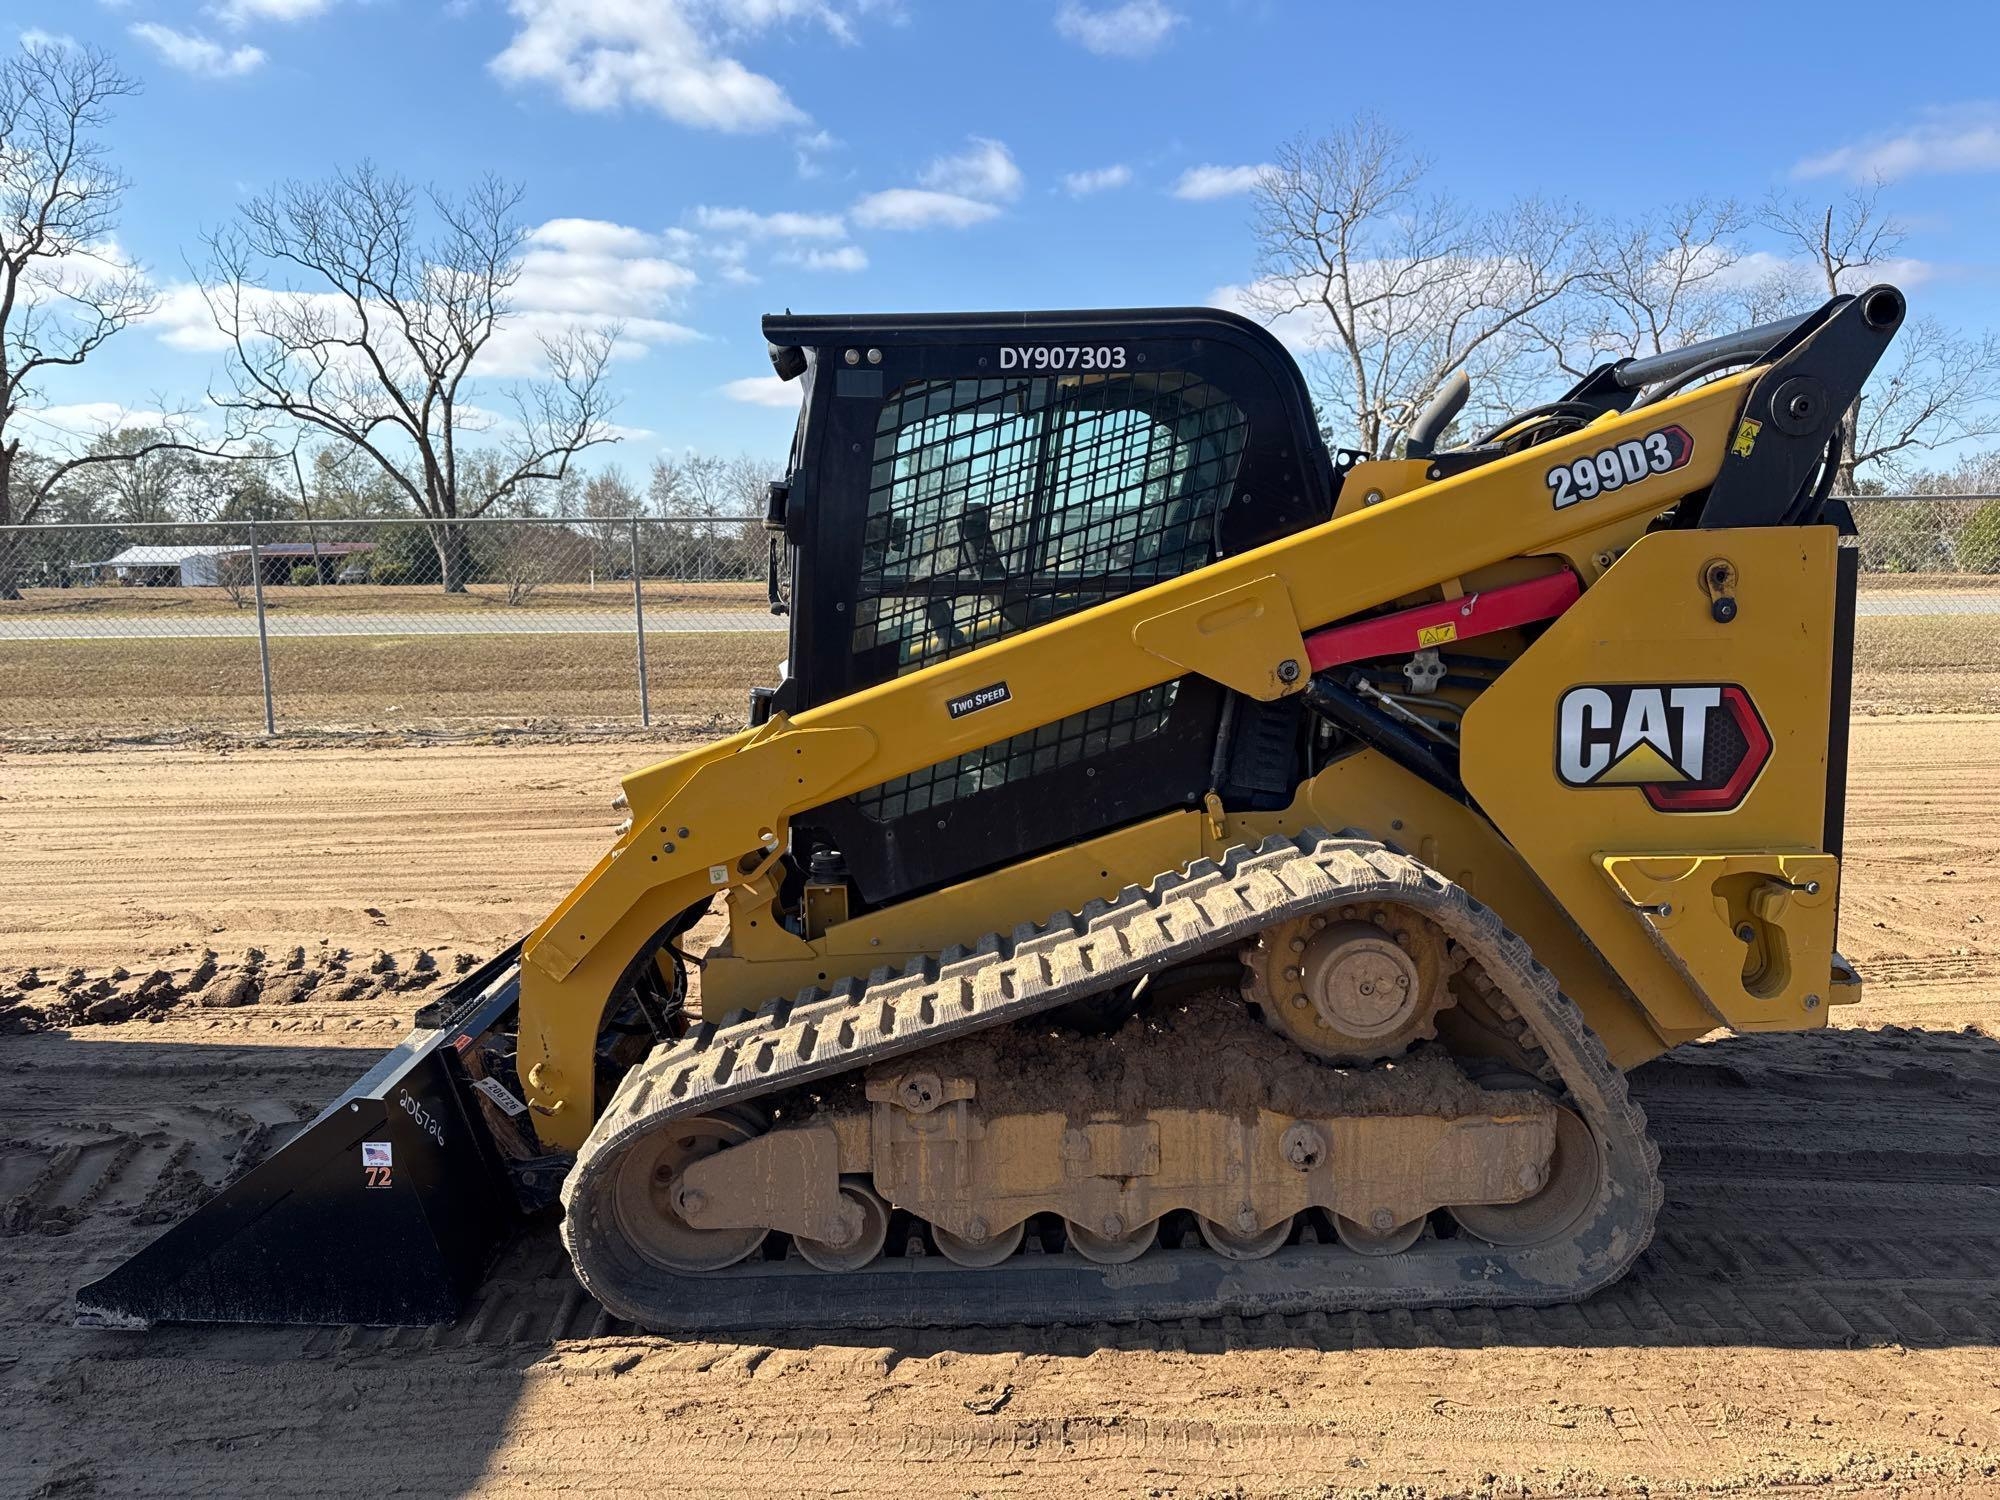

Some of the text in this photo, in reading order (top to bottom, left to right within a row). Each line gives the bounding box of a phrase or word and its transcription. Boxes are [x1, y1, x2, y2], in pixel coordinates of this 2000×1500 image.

[1000, 347, 1126, 369] DY907303
[1548, 433, 1673, 508] 299D3
[1560, 687, 1721, 784] CAT
[399, 1088, 445, 1147] 206726
[488, 1084, 519, 1110] 206726
[365, 1167, 392, 1186] 72
